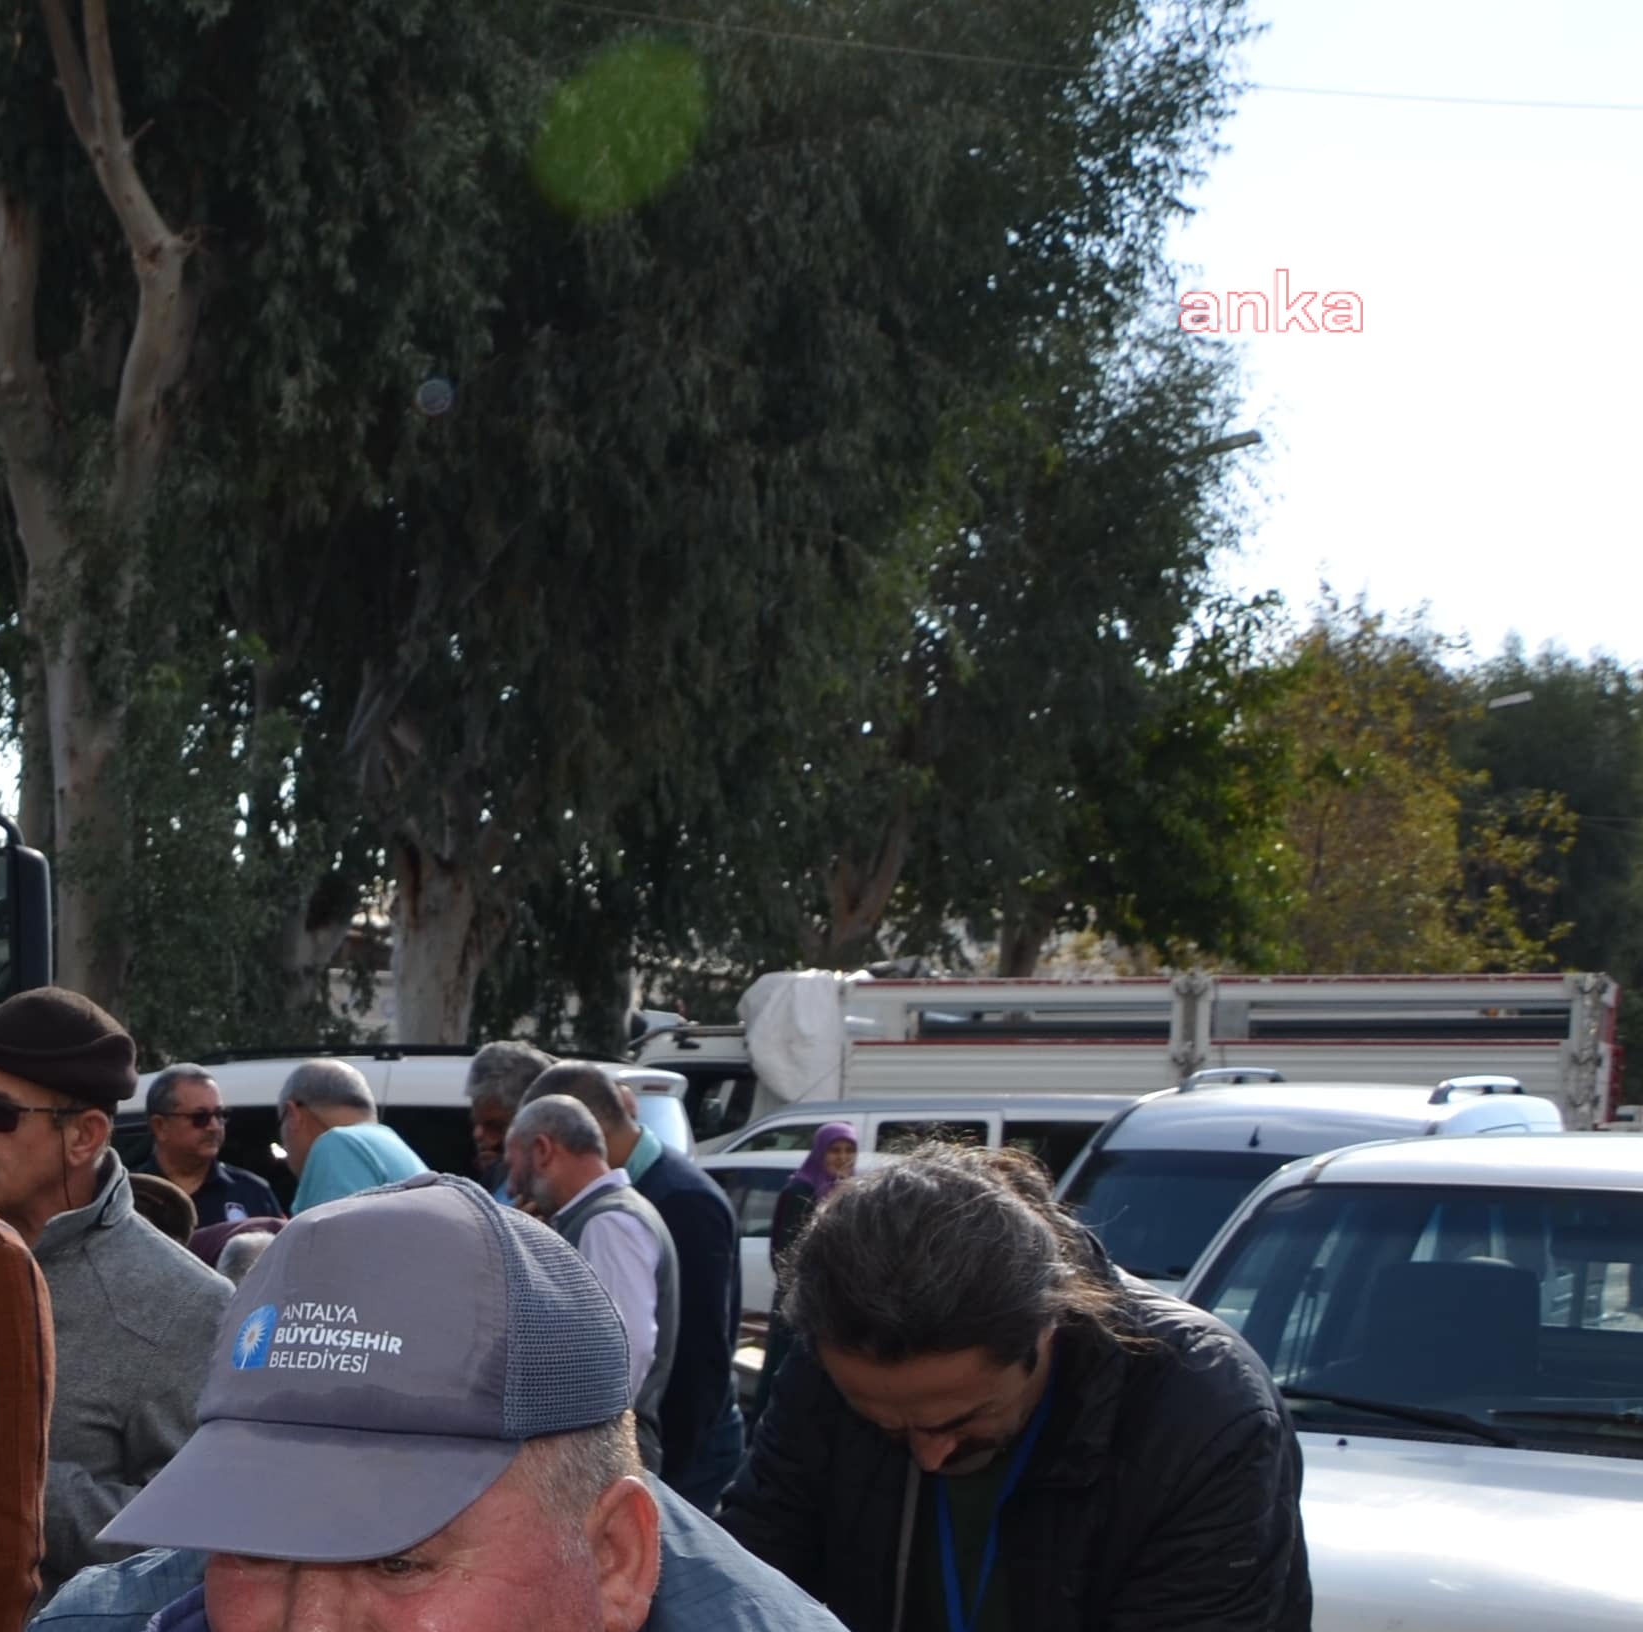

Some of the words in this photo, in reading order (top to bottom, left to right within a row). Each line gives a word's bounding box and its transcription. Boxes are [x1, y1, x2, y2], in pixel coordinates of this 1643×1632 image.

[282, 1302, 358, 1324] ANTALYA
[275, 1322, 403, 1354] BÜYÜKŞEHİR
[269, 1349, 369, 1373] BELEDİYESİ
